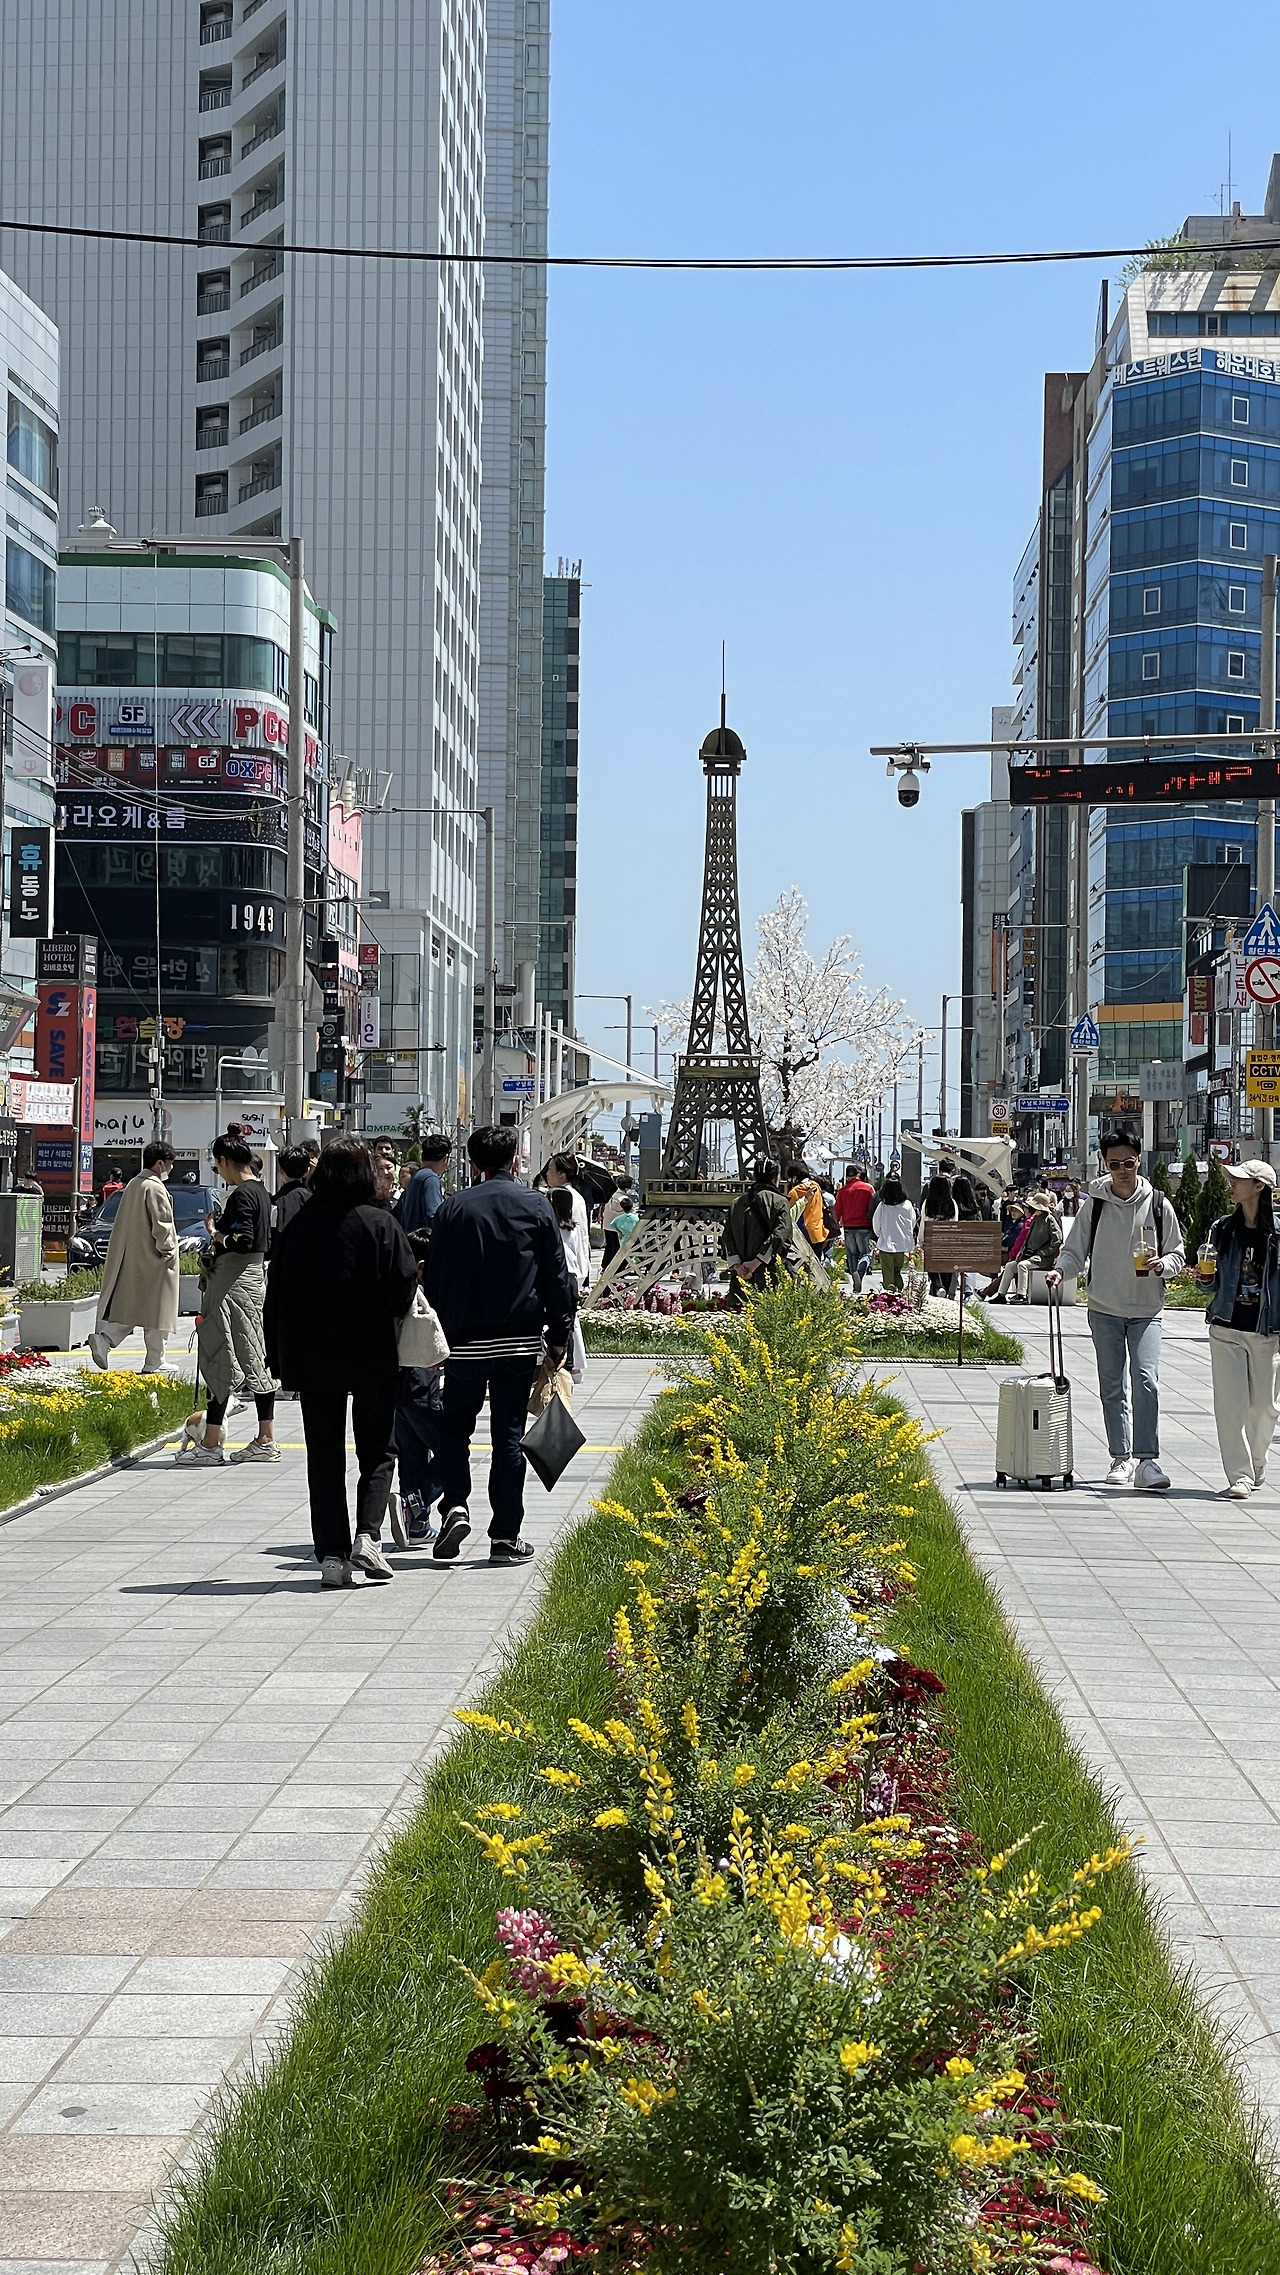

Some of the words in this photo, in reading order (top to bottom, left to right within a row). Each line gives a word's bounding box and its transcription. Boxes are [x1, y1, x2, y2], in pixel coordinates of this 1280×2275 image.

[1113, 347, 1202, 385] 베스트웨스턴
[121, 706, 144, 722] 5F
[200, 757, 215, 767] 5F
[225, 759, 273, 783] OXPC
[230, 903, 275, 933] 1943
[42, 943, 77, 952] LIBERO
[43, 953, 75, 962] HOTEL
[43, 963, 75, 974] 리베로호텔
[1193, 978, 1208, 1010] BAR
[363, 1023, 374, 1043] CU
[49, 1029, 66, 1078] SAVE
[995, 1107, 1004, 1116] 30
[42, 1204, 71, 1213] IBERO
[43, 1224, 70, 1235] 베로호텔
